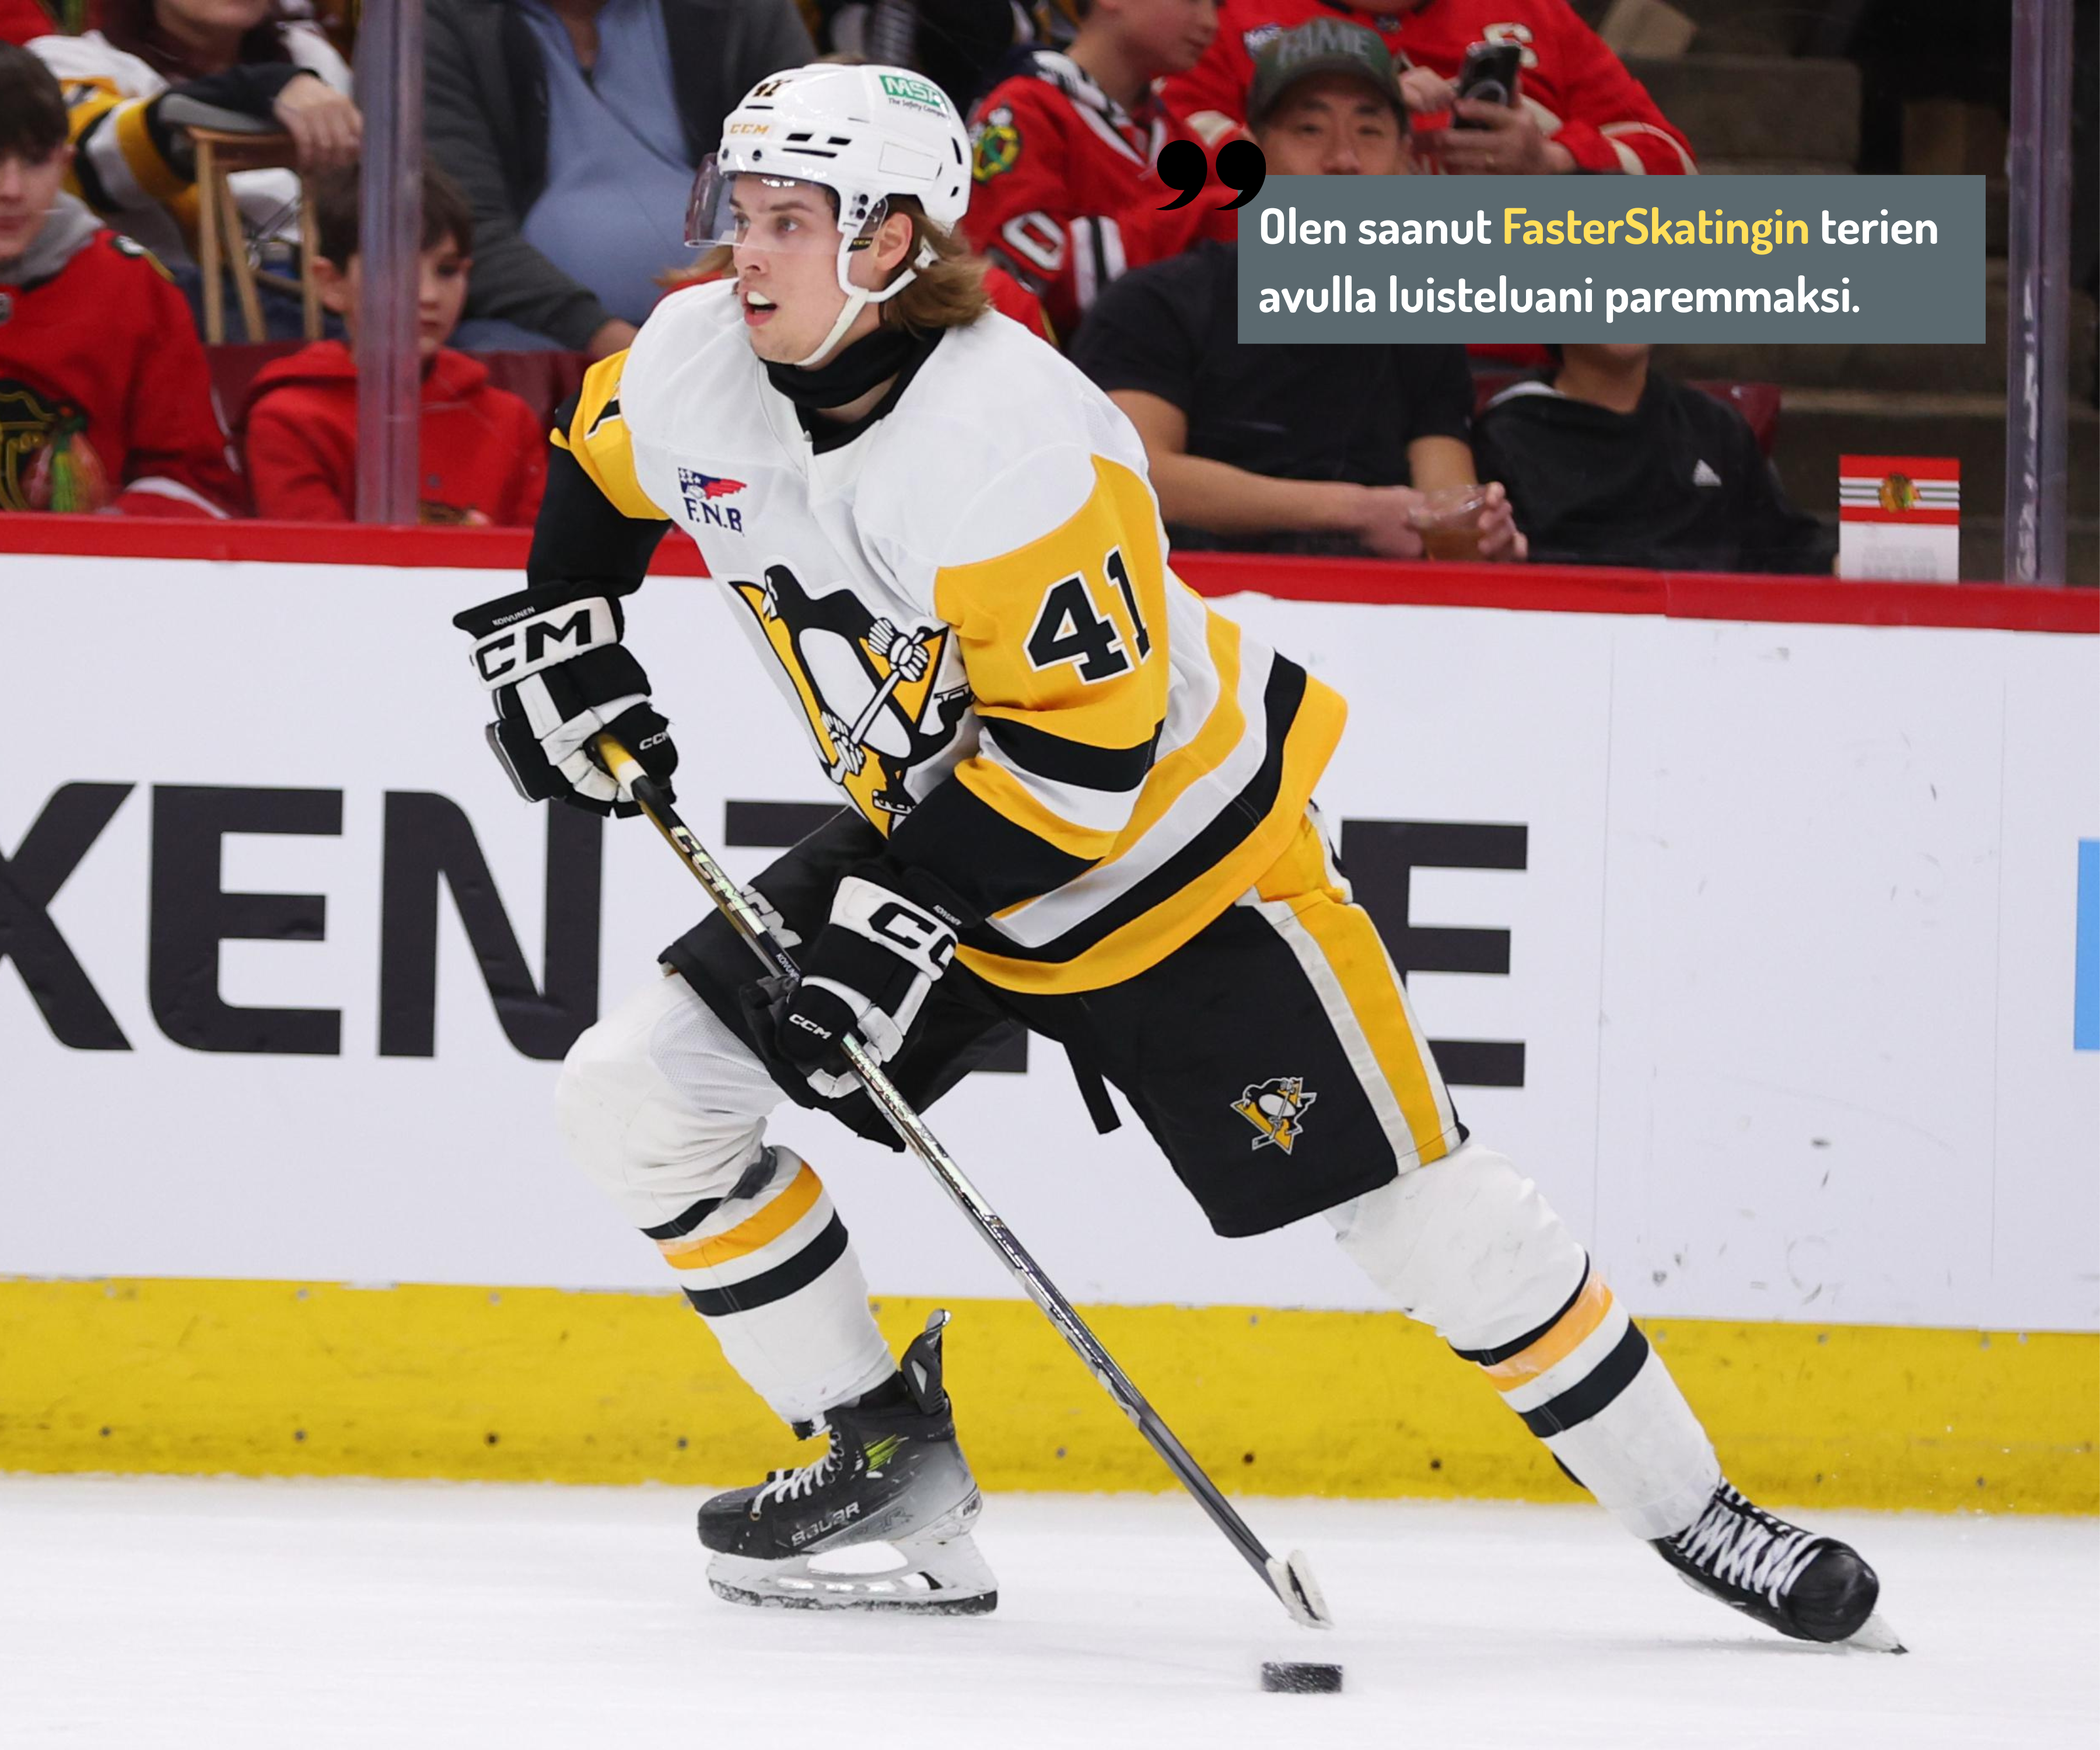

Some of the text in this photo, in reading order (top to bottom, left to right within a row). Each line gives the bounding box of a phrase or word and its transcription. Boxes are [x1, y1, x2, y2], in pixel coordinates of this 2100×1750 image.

[730, 124, 770, 134] CCM
[1022, 544, 1152, 685] 41
[789, 1013, 832, 1040] CCM
